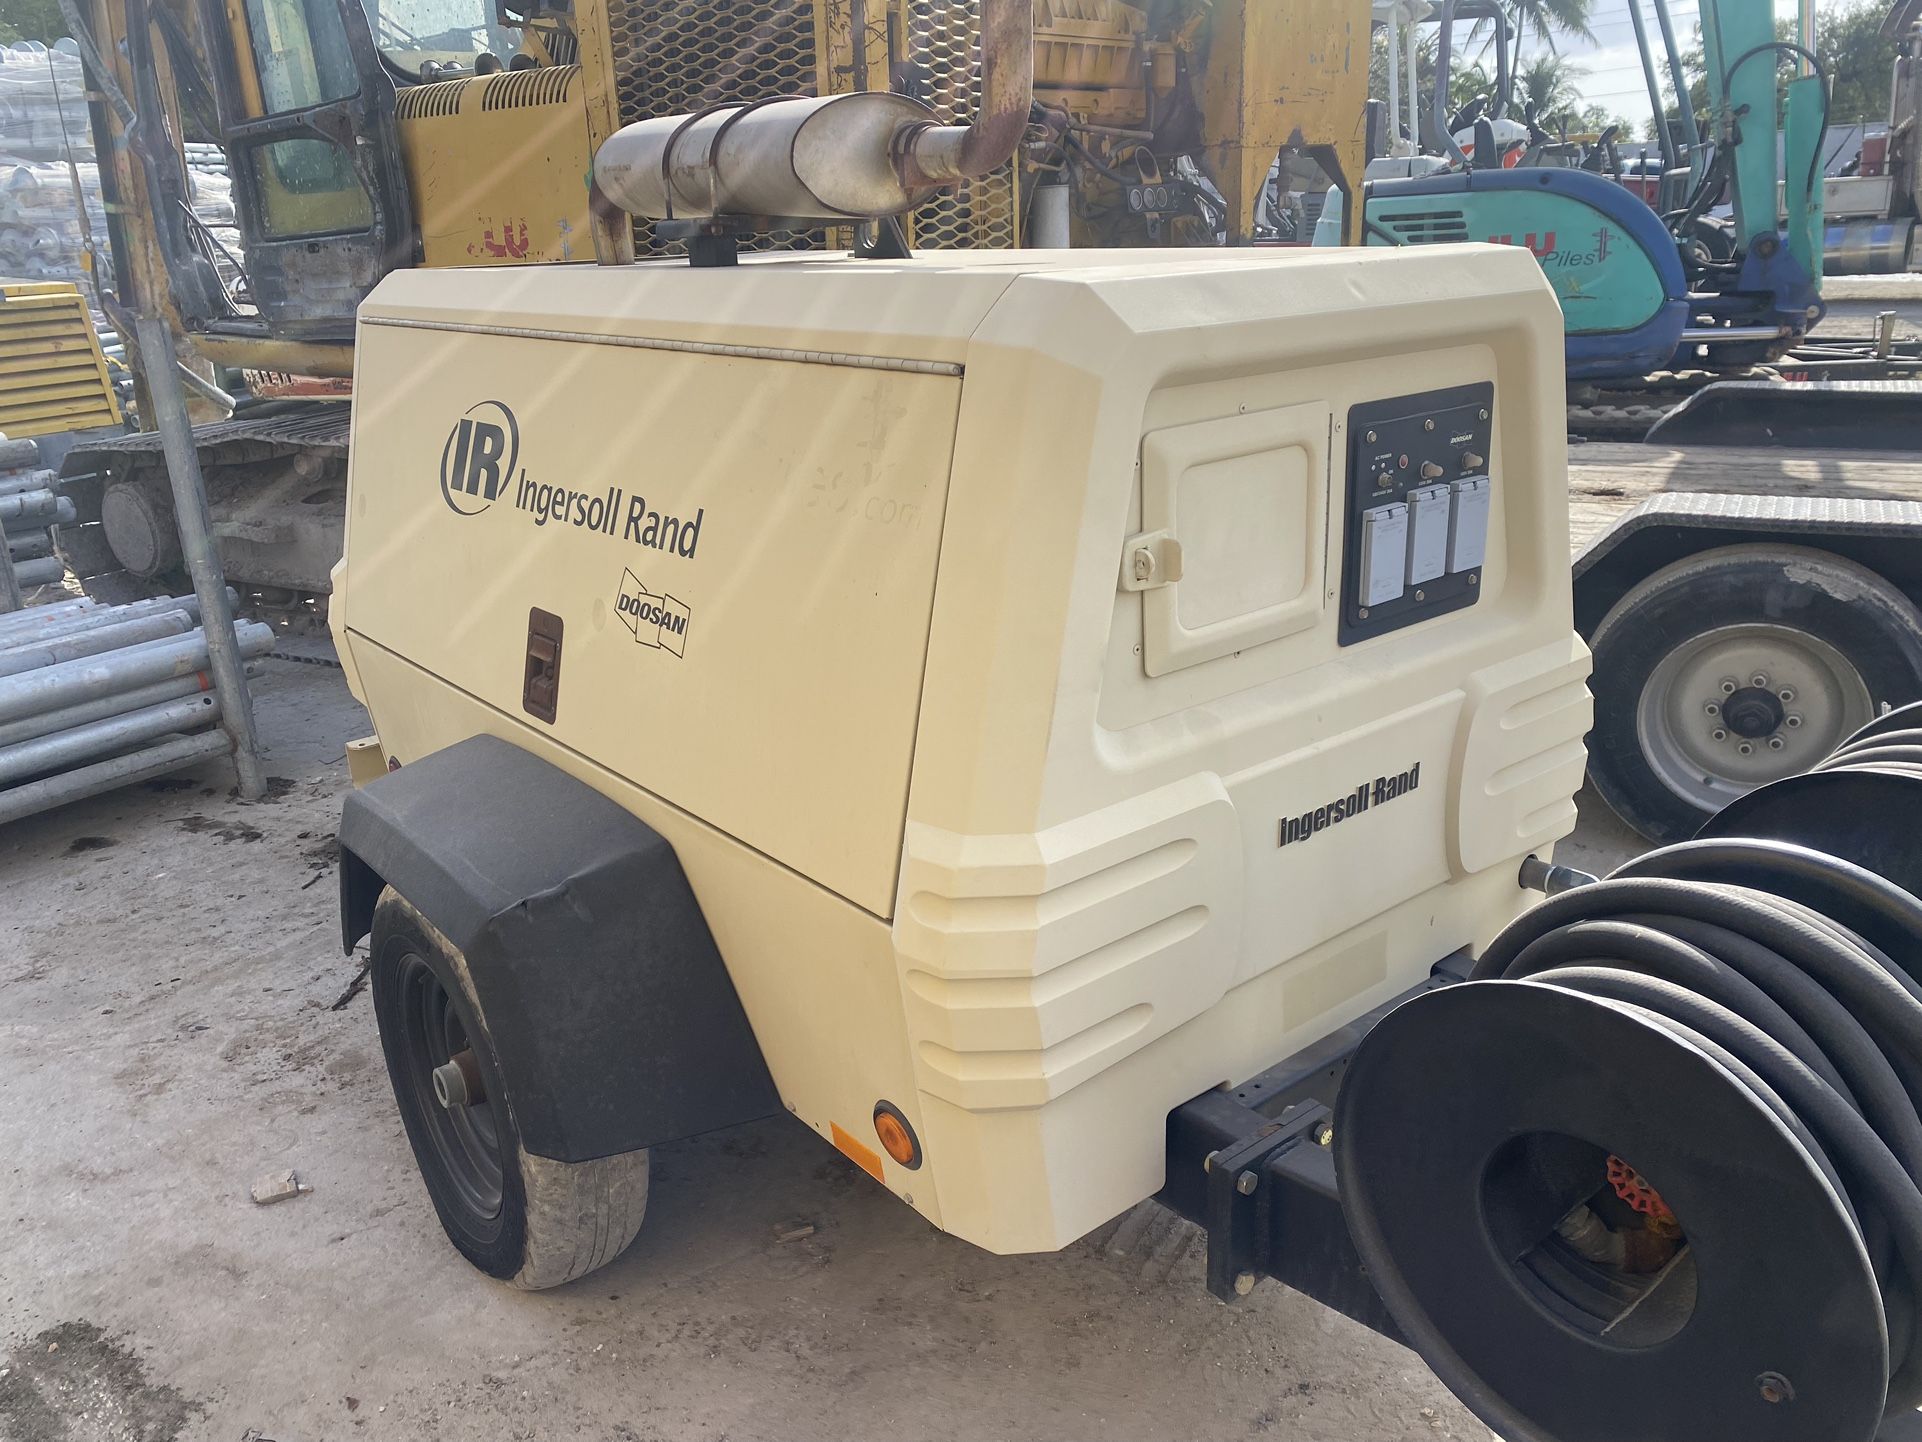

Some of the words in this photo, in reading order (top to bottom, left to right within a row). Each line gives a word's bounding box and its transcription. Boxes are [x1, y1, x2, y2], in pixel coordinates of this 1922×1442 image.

[1541, 250, 1596, 268] Piles
[1450, 433, 1473, 444] DOOSAN
[450, 419, 504, 501] IR
[516, 468, 622, 535] Ingersoll
[623, 496, 704, 559] Rand
[618, 593, 687, 635] DOOSAN
